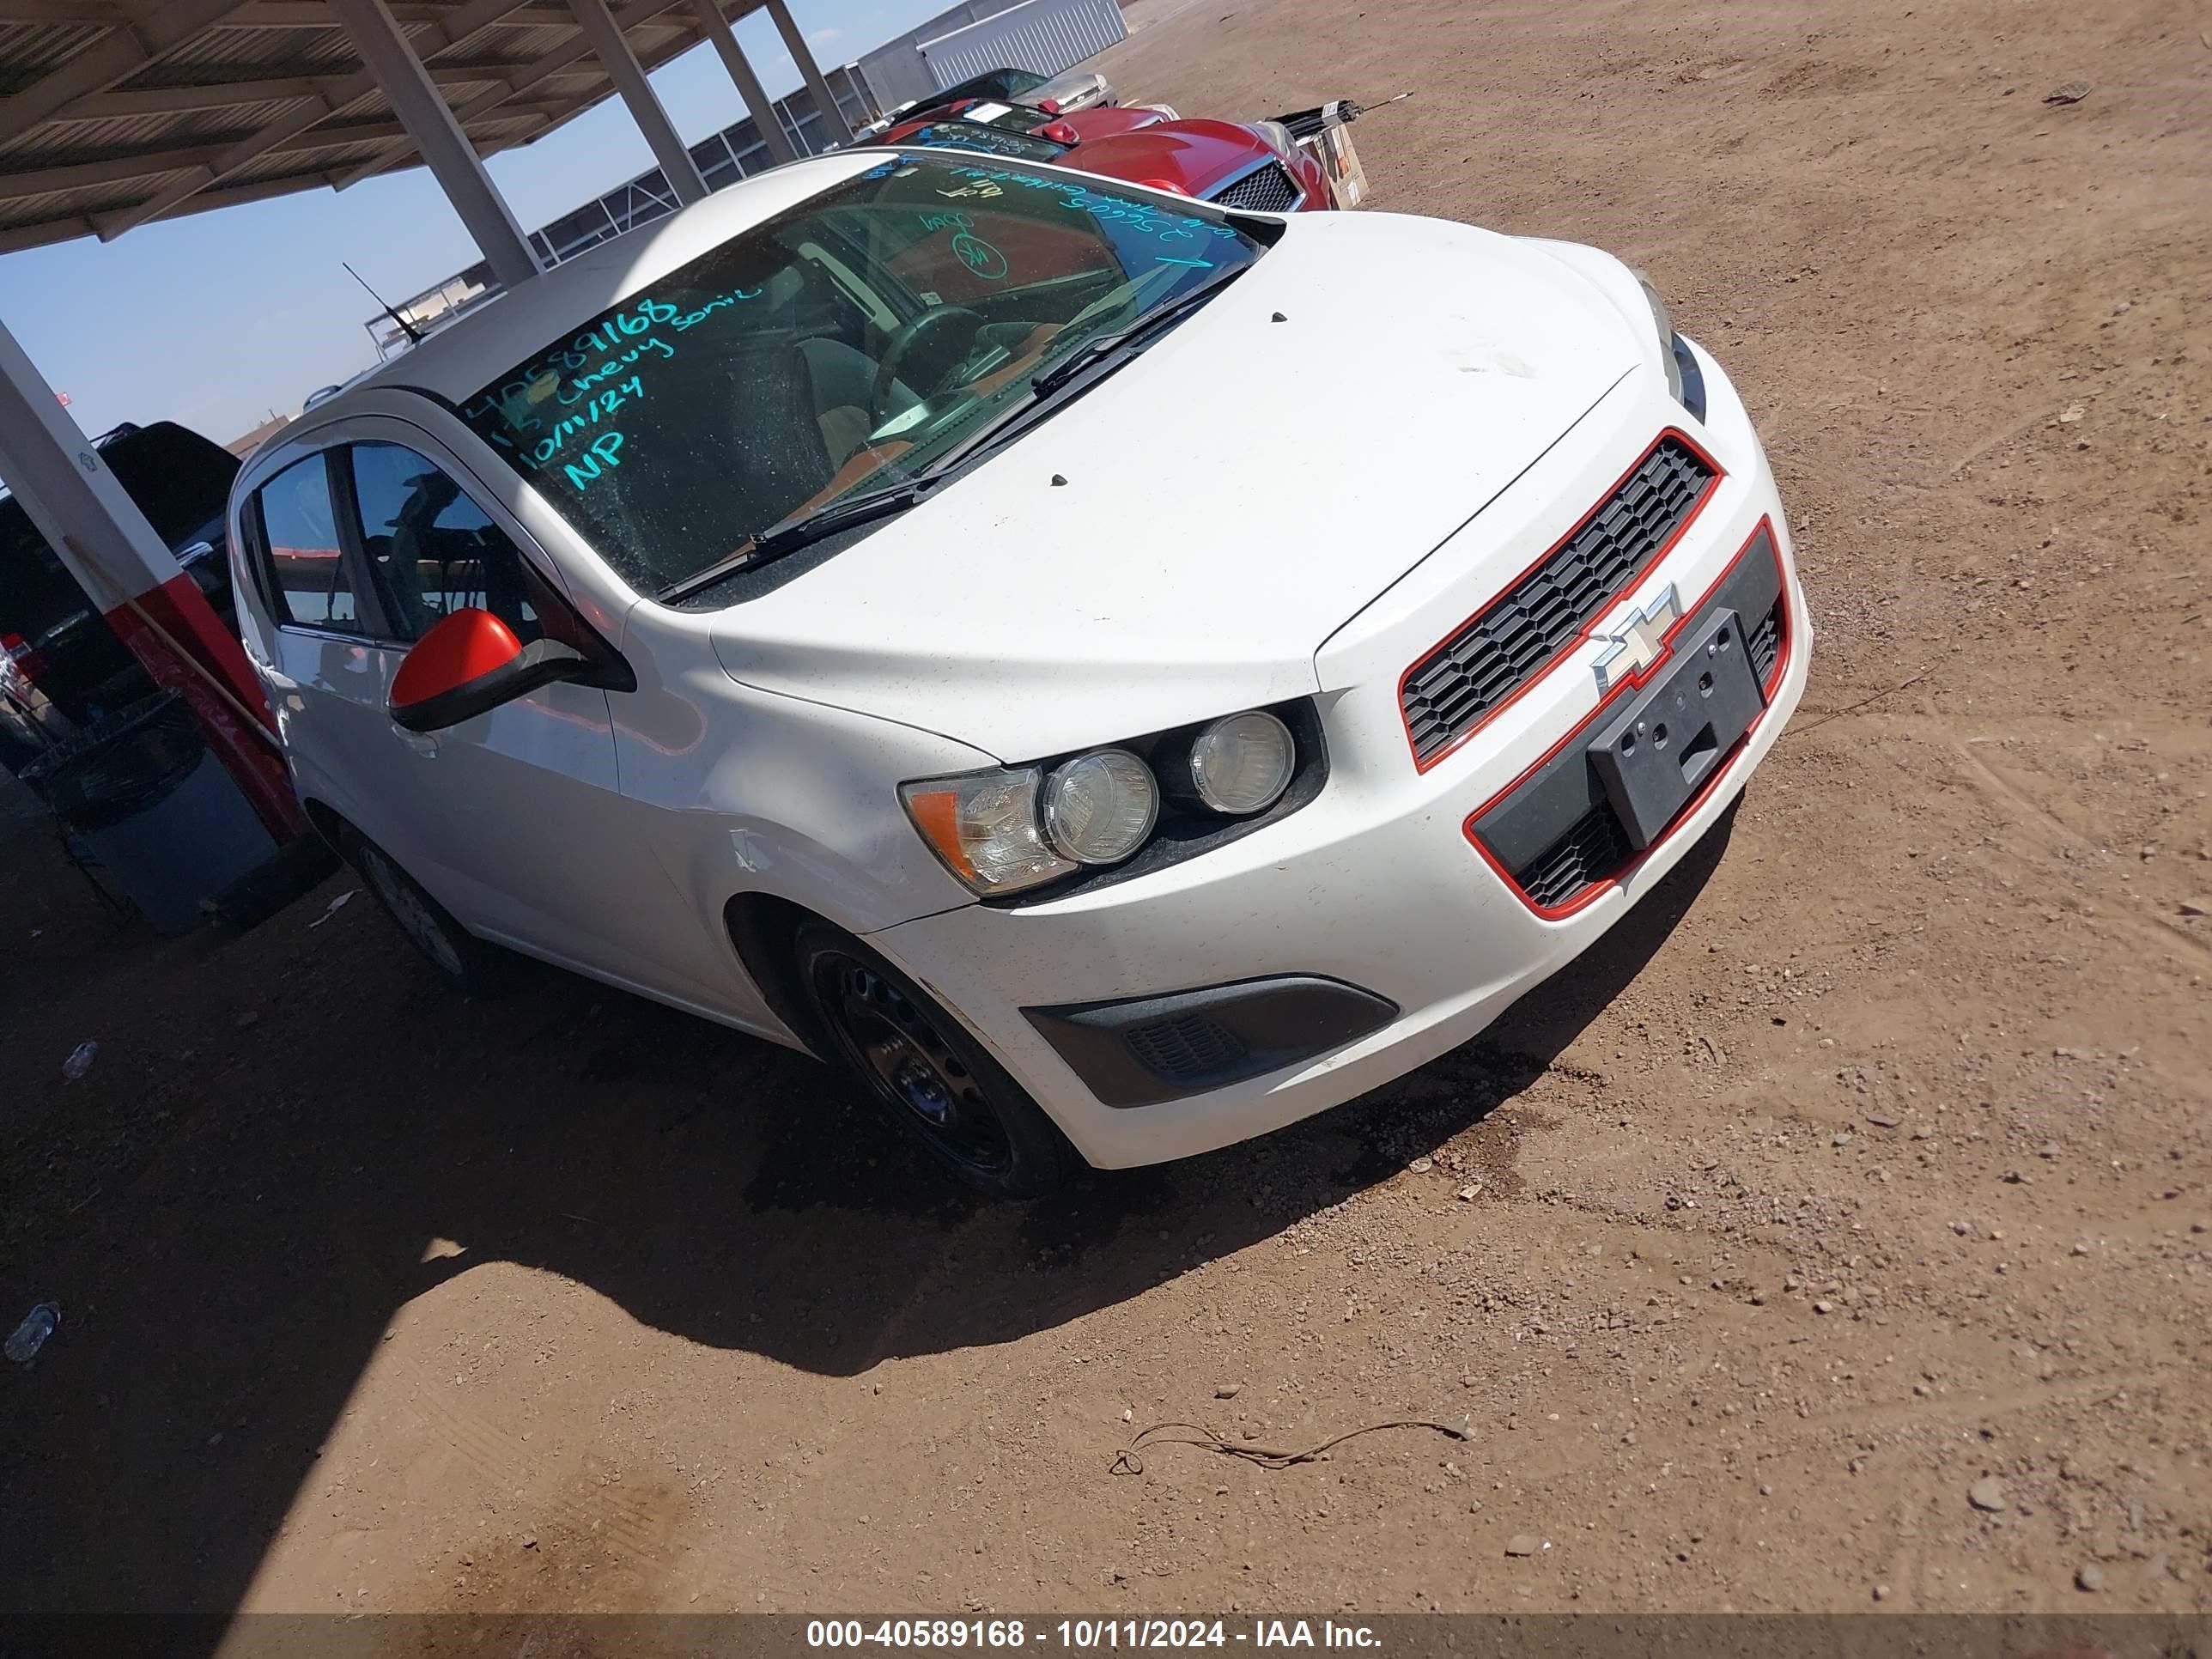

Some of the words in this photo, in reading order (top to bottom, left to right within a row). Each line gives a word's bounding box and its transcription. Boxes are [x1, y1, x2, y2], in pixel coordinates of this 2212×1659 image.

[1059, 198, 1194, 242] 256605
[465, 298, 678, 420] 40589168
[556, 336, 675, 405] Chevy
[519, 375, 645, 471] 10/11/24
[562, 430, 624, 492] NP
